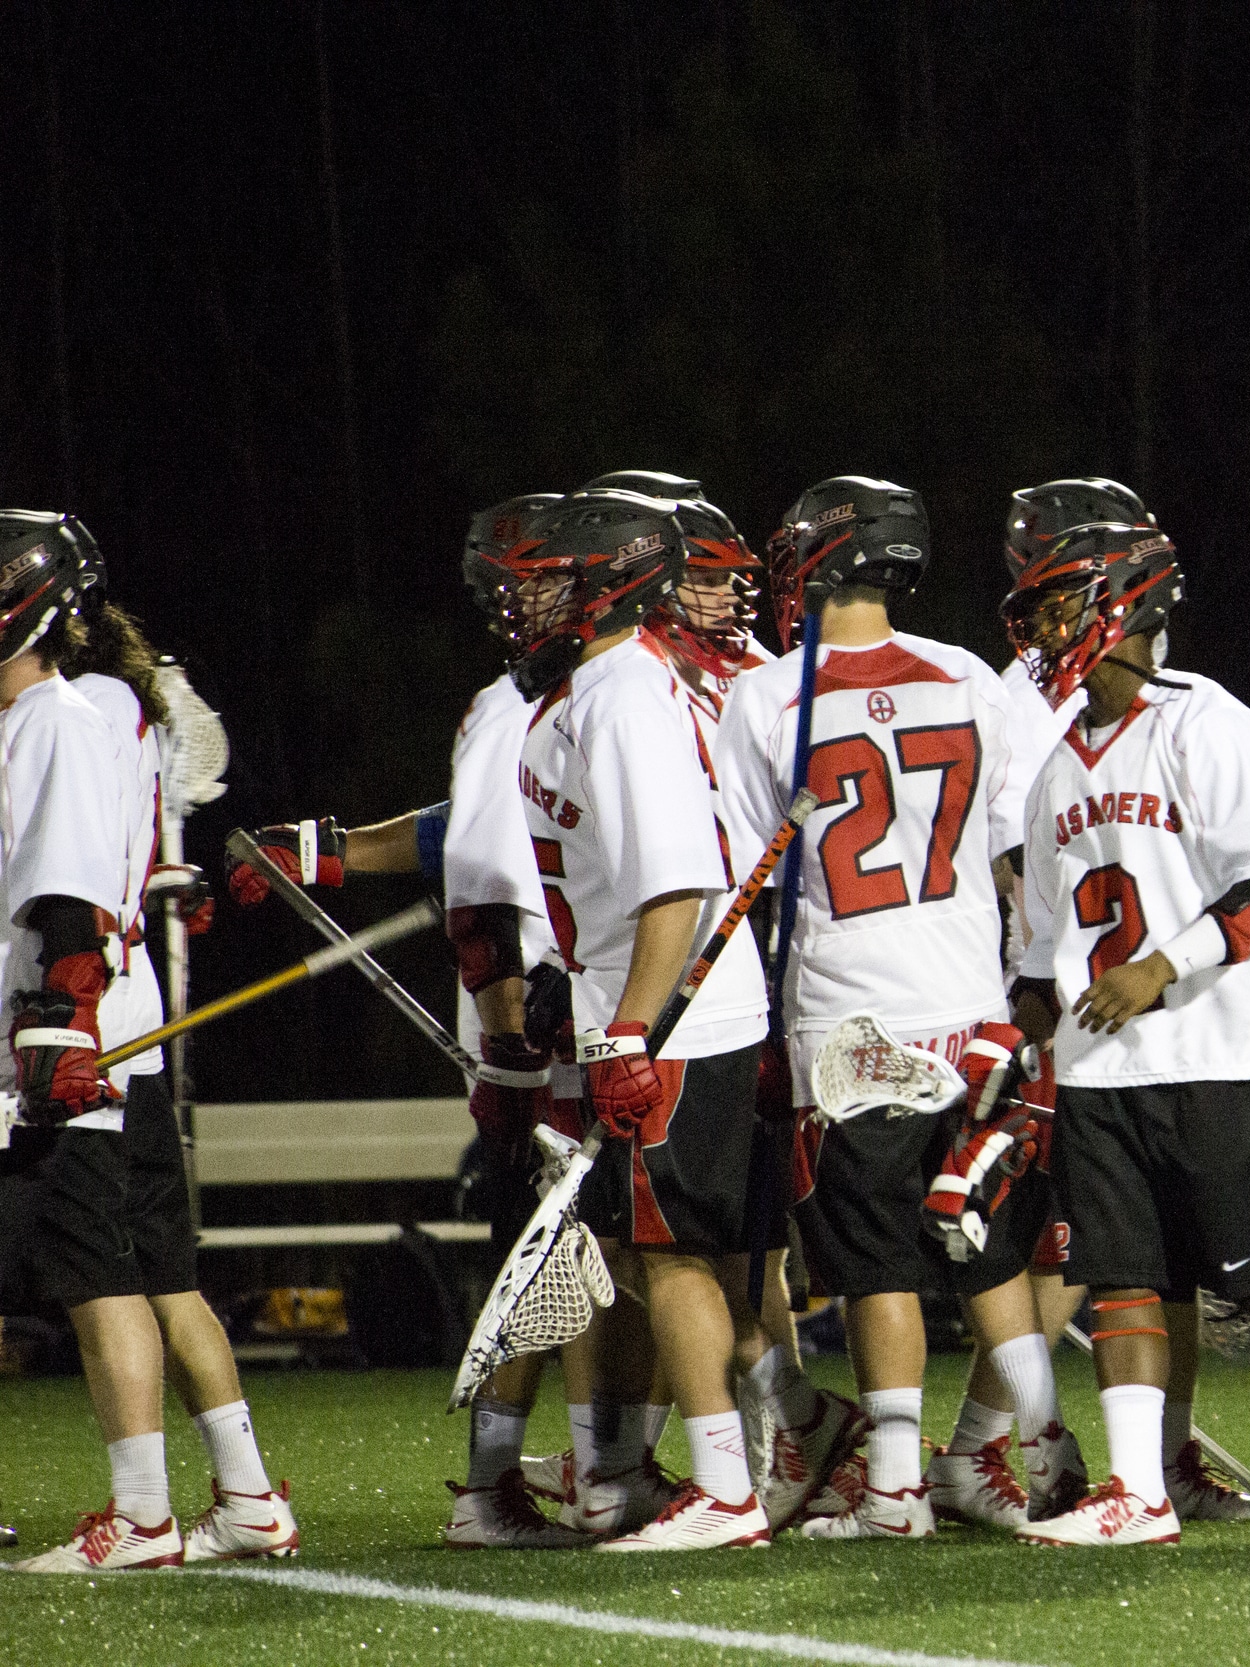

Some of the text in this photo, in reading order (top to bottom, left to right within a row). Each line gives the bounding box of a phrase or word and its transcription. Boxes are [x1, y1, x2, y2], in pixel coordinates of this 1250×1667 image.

[806, 719, 982, 921] 27
[1072, 862, 1166, 1016] 2
[584, 1040, 619, 1057] STX
